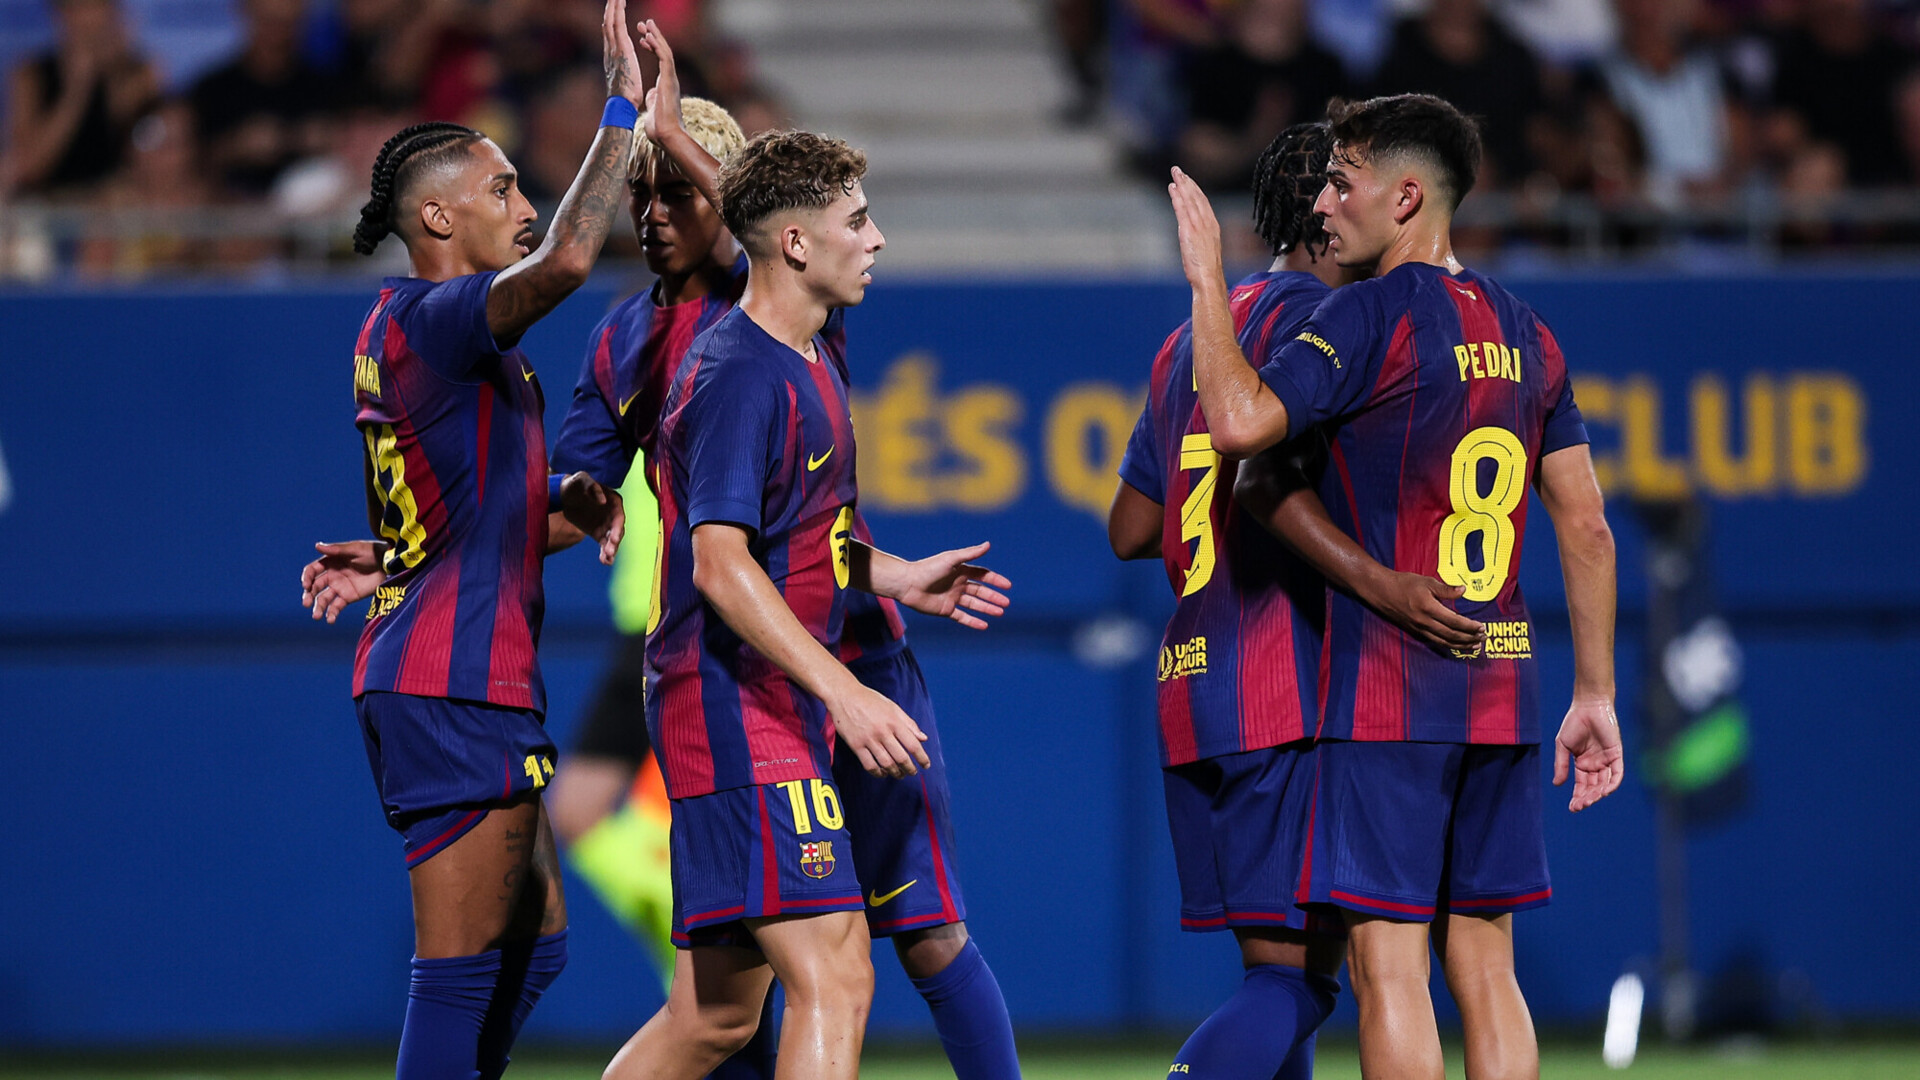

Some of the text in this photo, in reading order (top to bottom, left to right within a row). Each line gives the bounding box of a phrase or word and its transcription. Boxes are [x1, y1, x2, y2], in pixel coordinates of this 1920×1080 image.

[1453, 341, 1521, 383] PEDRI
[1180, 433, 1219, 597] 3
[1437, 426, 1528, 602] 8
[1482, 622, 1528, 637] UNHCR
[1485, 637, 1531, 652] ACNUR
[523, 755, 556, 788] 11
[775, 778, 844, 834] 16
